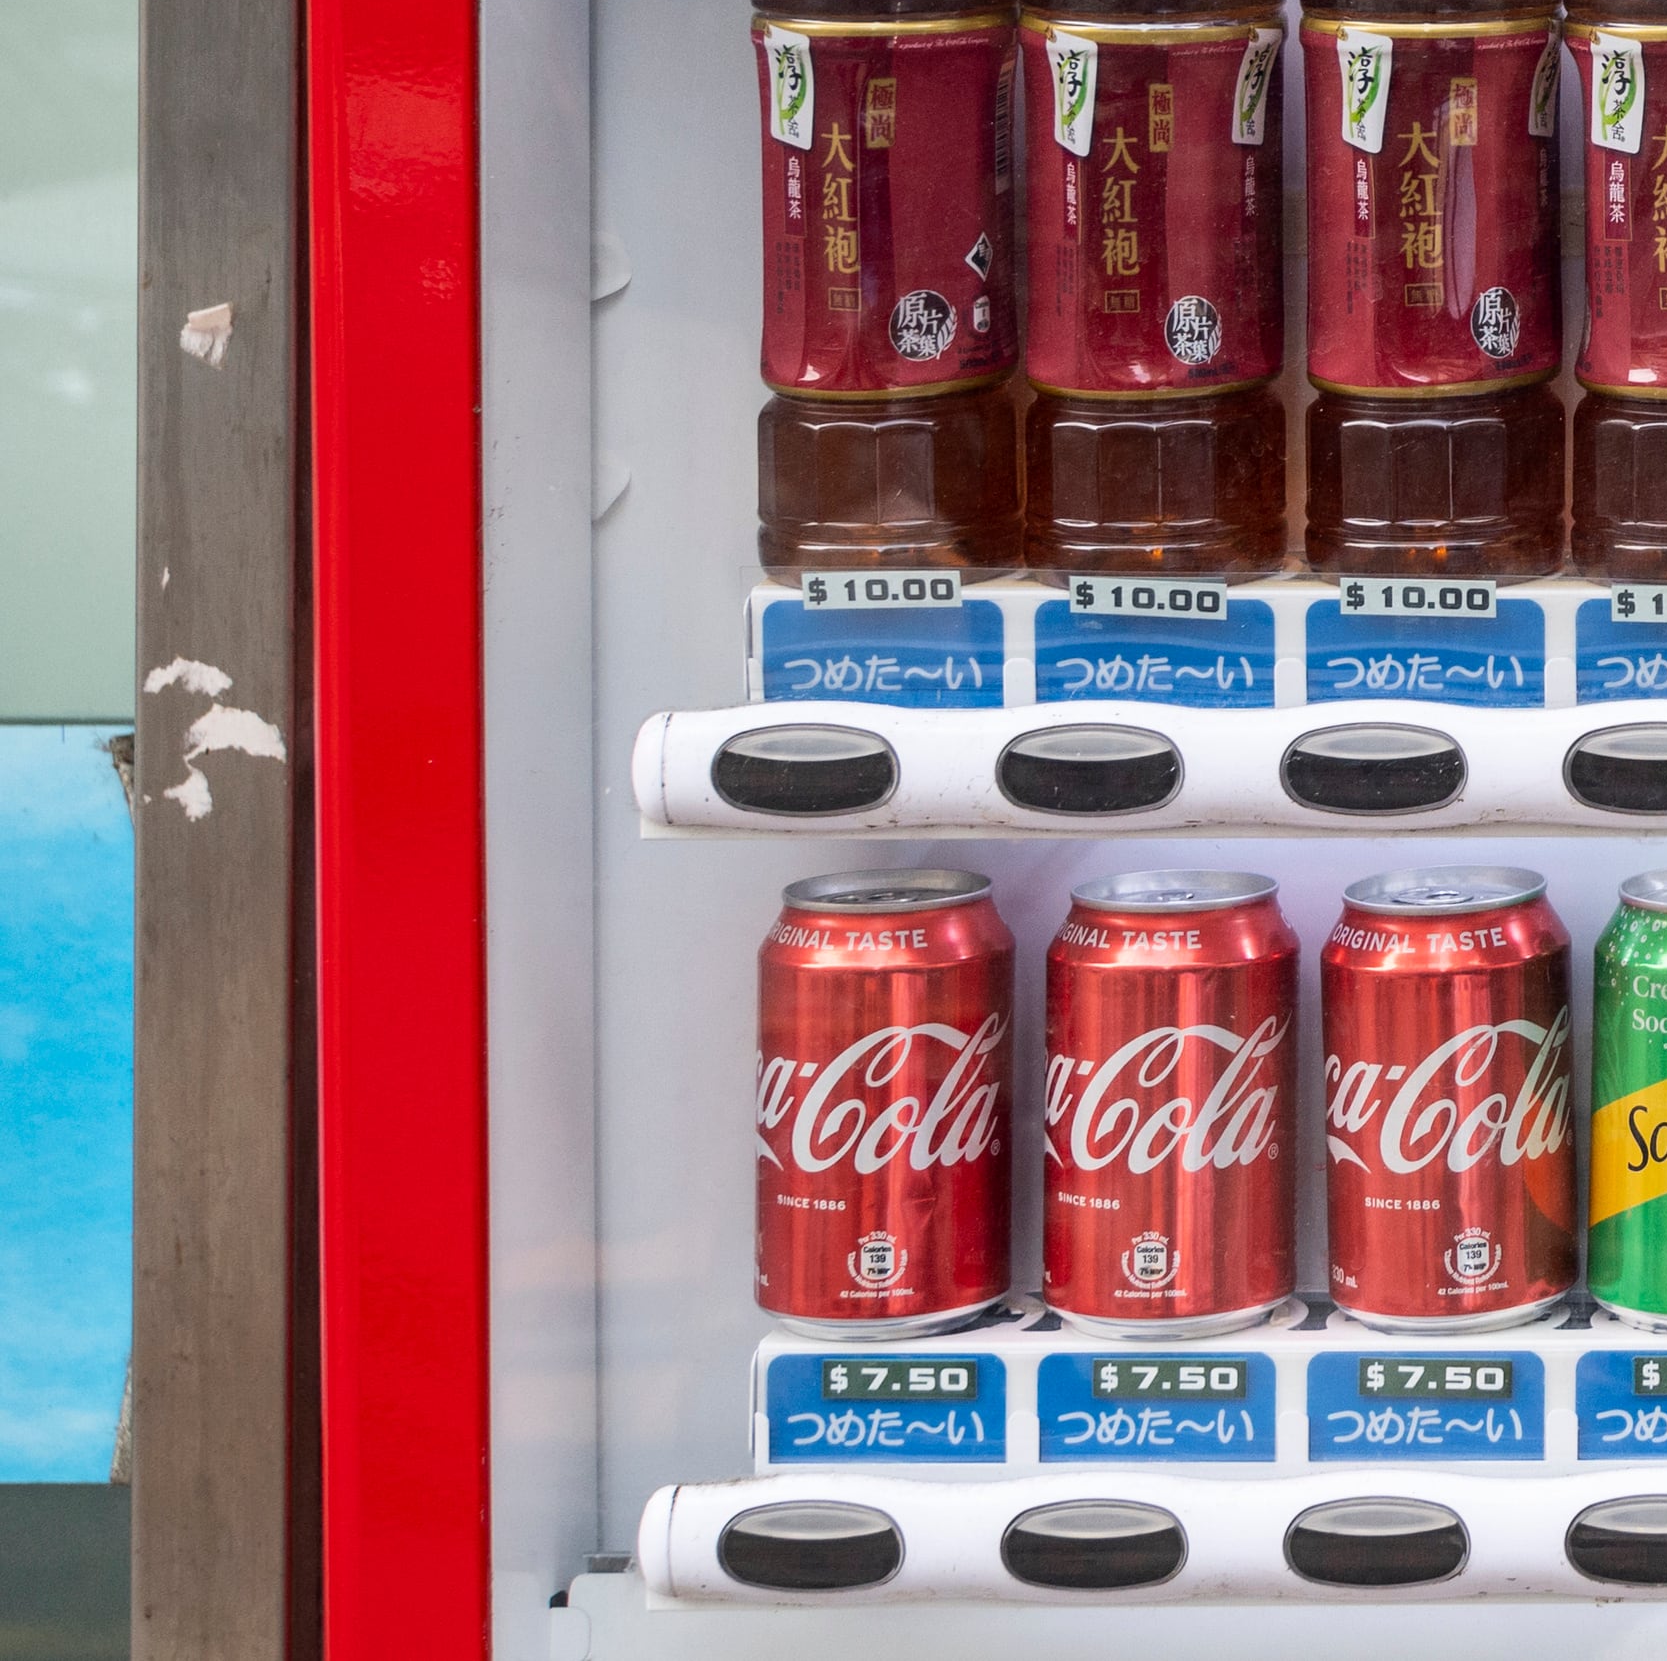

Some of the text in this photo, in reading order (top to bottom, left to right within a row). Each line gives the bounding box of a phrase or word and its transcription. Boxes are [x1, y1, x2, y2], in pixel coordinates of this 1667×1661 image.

[820, 123, 861, 275] 大紅袍
[1102, 127, 1141, 277] 大紅袍
[1332, 923, 1507, 954] ORIGINAL TASTE
